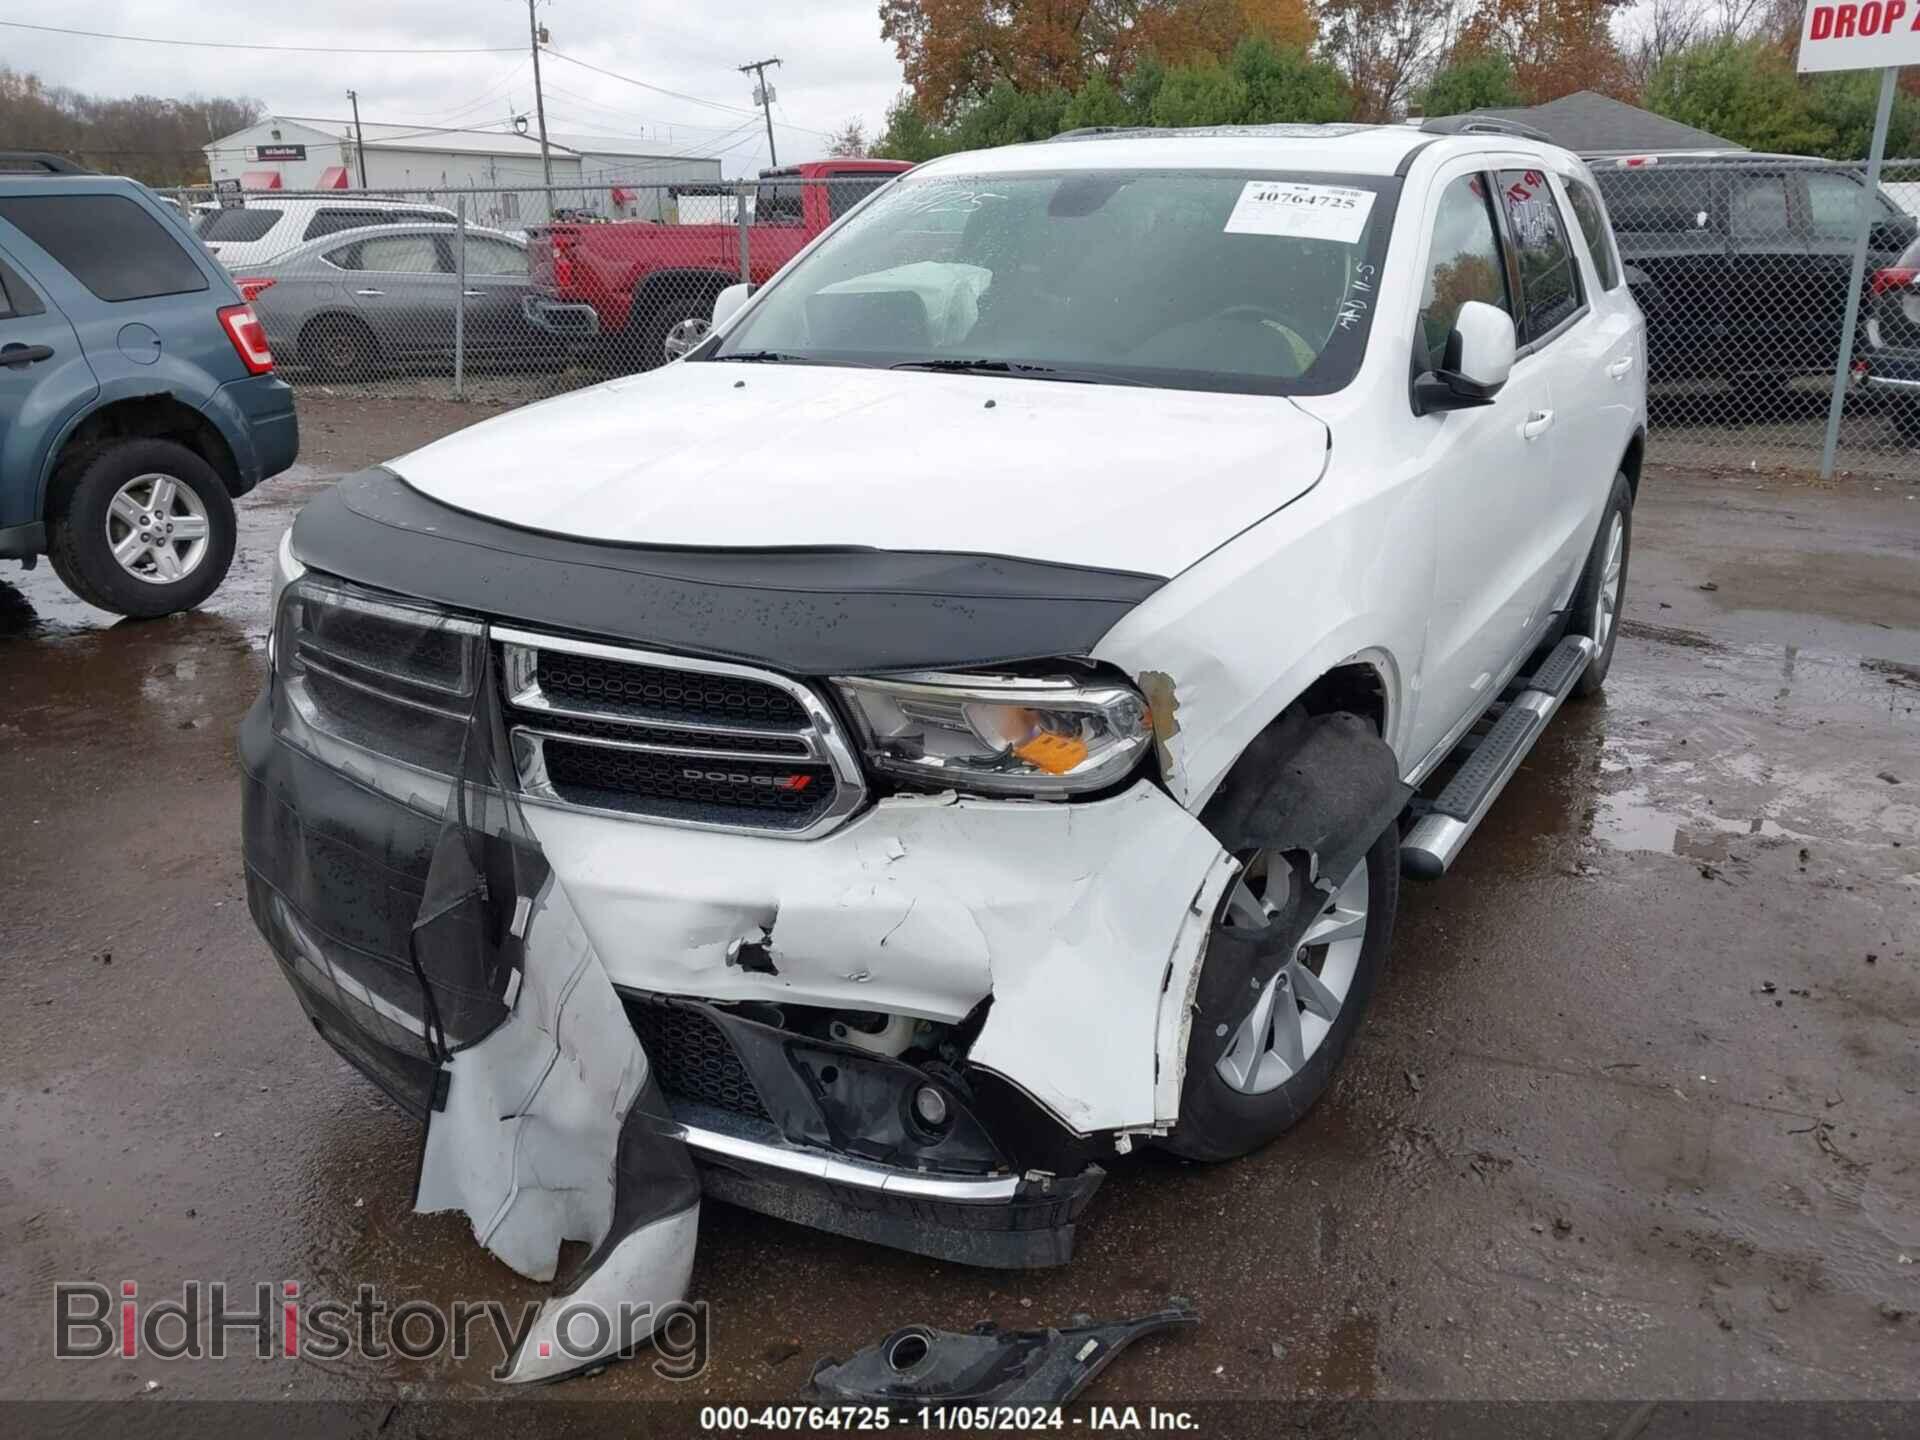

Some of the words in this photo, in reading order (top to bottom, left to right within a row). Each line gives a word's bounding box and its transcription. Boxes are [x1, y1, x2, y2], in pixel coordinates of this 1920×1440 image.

[1810, 0, 1906, 41] DROP
[1253, 190, 1356, 210] 40764725
[683, 769, 794, 786] DODGE
